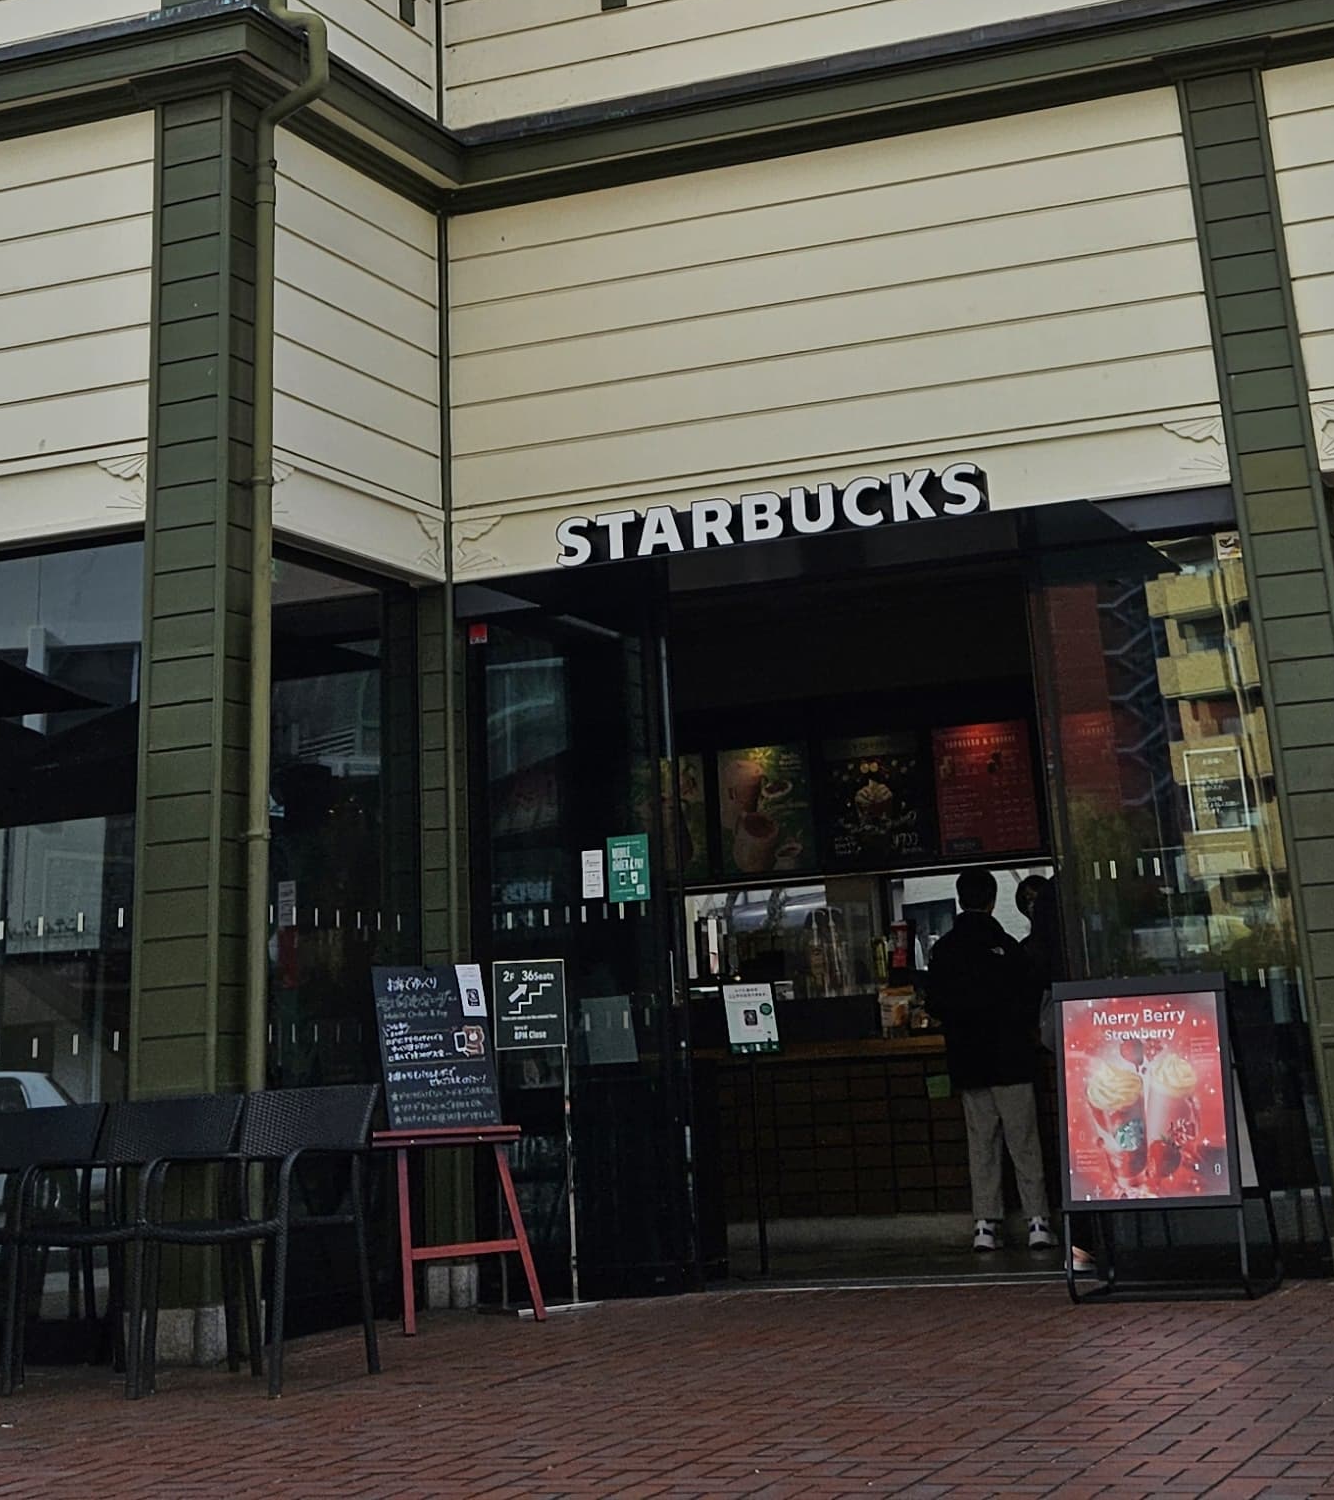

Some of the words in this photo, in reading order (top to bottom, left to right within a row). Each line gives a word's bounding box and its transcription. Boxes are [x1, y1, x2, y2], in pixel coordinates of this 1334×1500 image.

[556, 462, 985, 566] STARBUCKS
[1093, 1010, 1139, 1027] Merry
[1143, 1008, 1186, 1025] Berry
[1104, 1027, 1175, 1042] Strawberry
